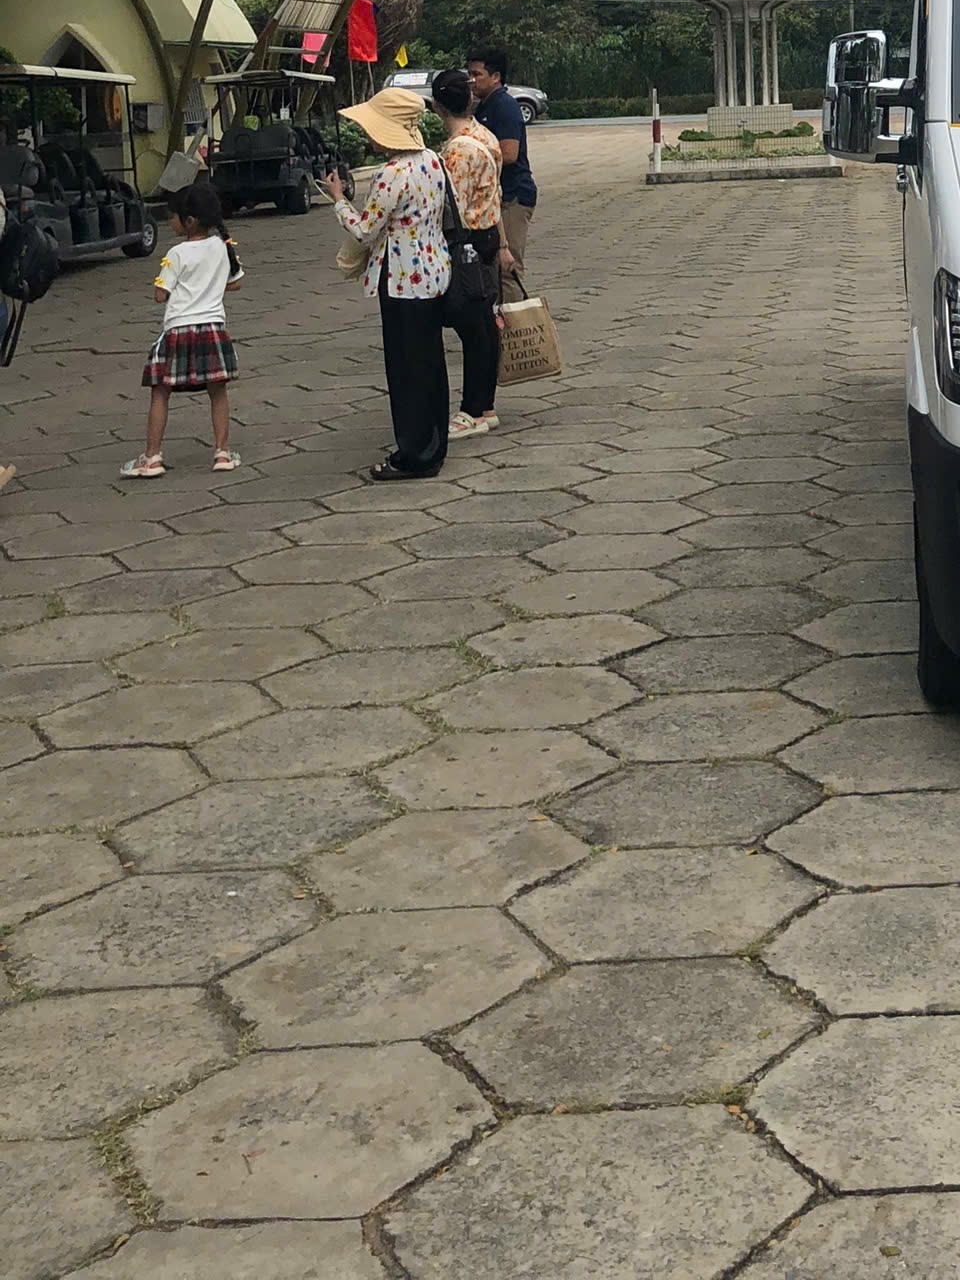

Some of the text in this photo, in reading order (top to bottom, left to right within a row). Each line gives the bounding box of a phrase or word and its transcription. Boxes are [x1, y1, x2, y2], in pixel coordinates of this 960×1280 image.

[500, 323, 544, 340] OMEDAY
[522, 337, 537, 348] BE
[538, 335, 545, 345] A
[510, 347, 541, 361] LOUIS
[504, 356, 549, 373] VUITTON
